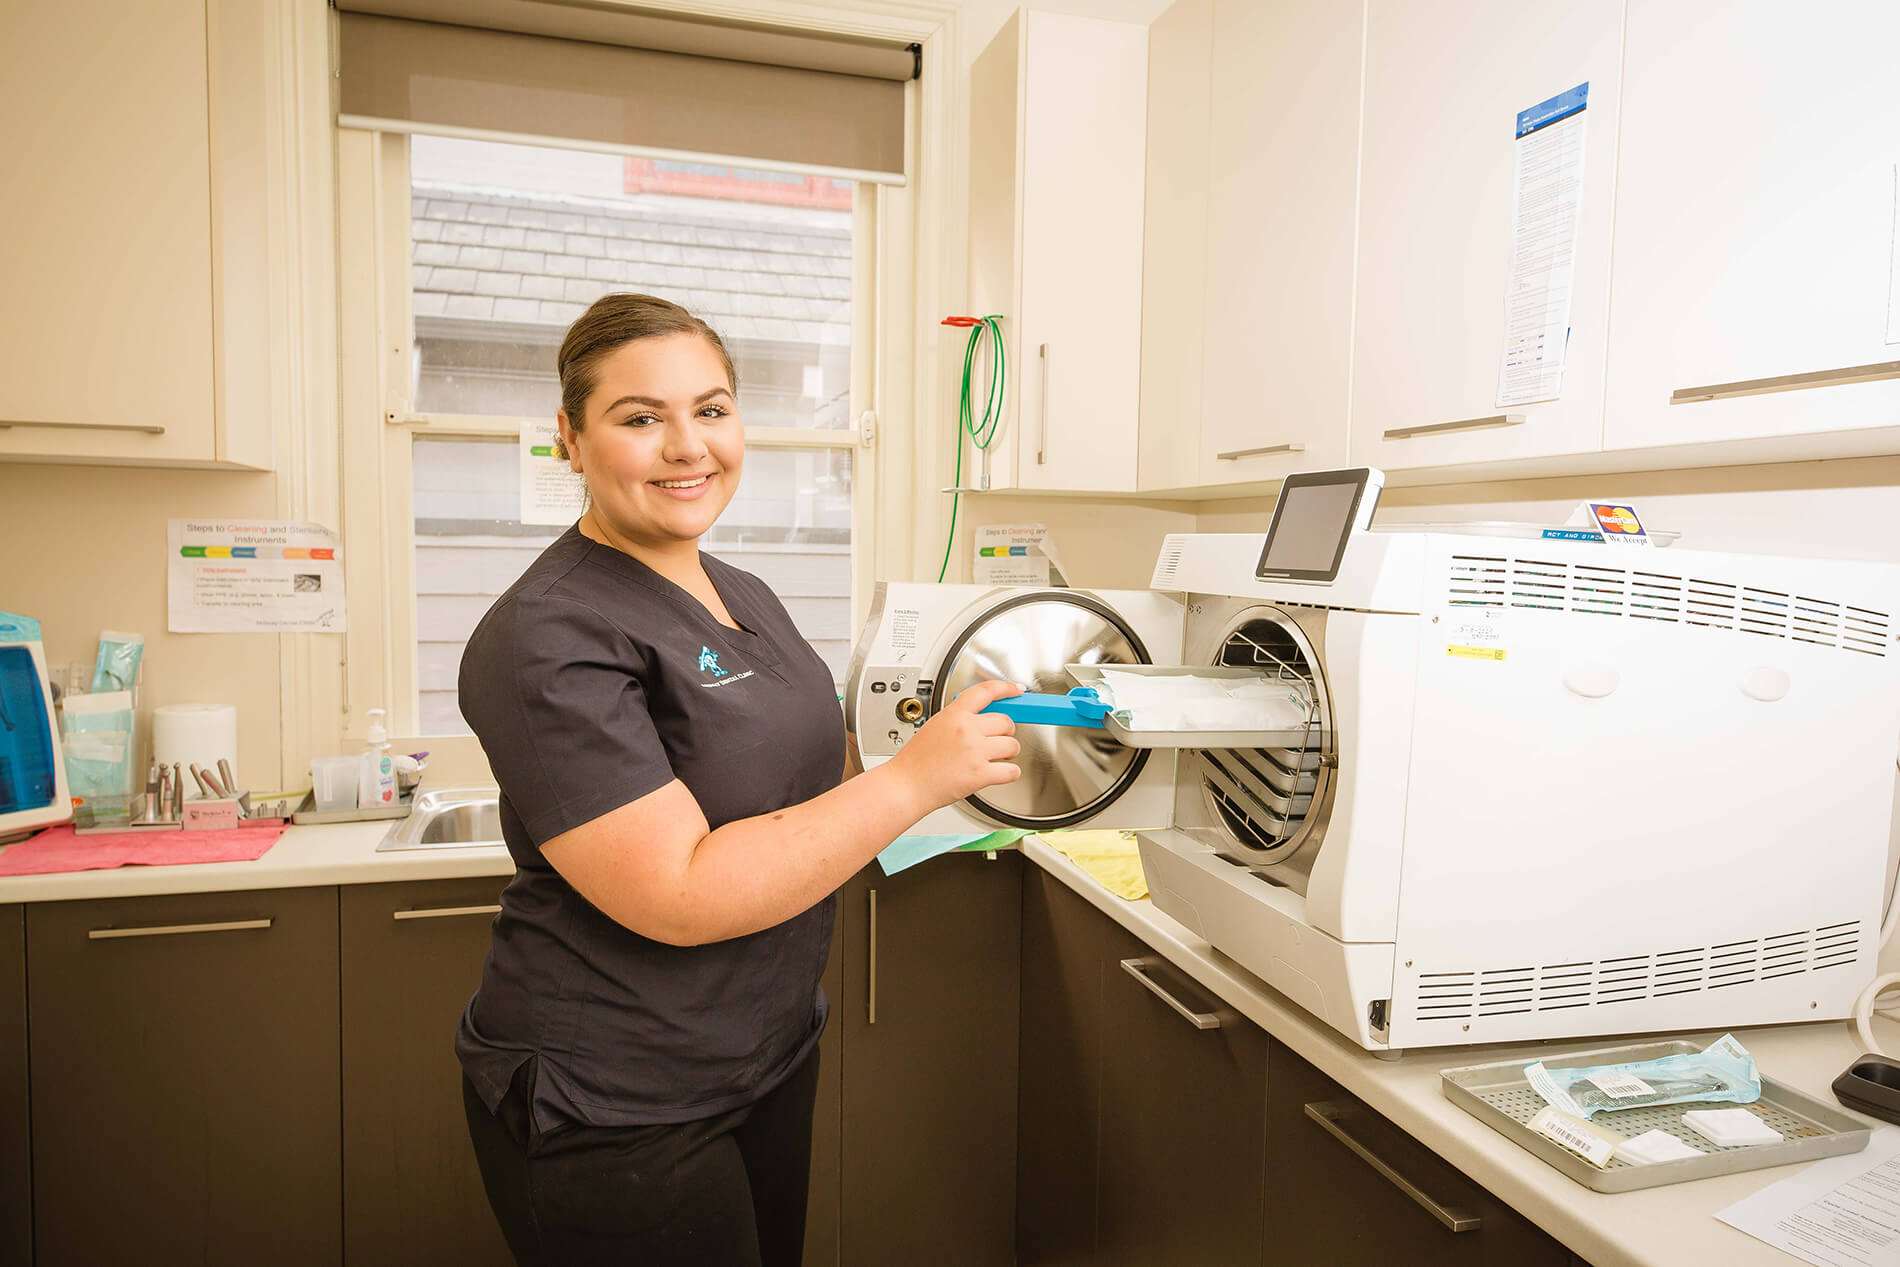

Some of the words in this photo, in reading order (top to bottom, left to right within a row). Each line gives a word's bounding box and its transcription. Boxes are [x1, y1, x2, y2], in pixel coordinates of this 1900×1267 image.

[186, 523, 213, 534] Steps
[215, 524, 225, 532] to
[227, 524, 267, 535] Cleaning
[269, 525, 286, 533] and
[234, 535, 287, 544] Instruments
